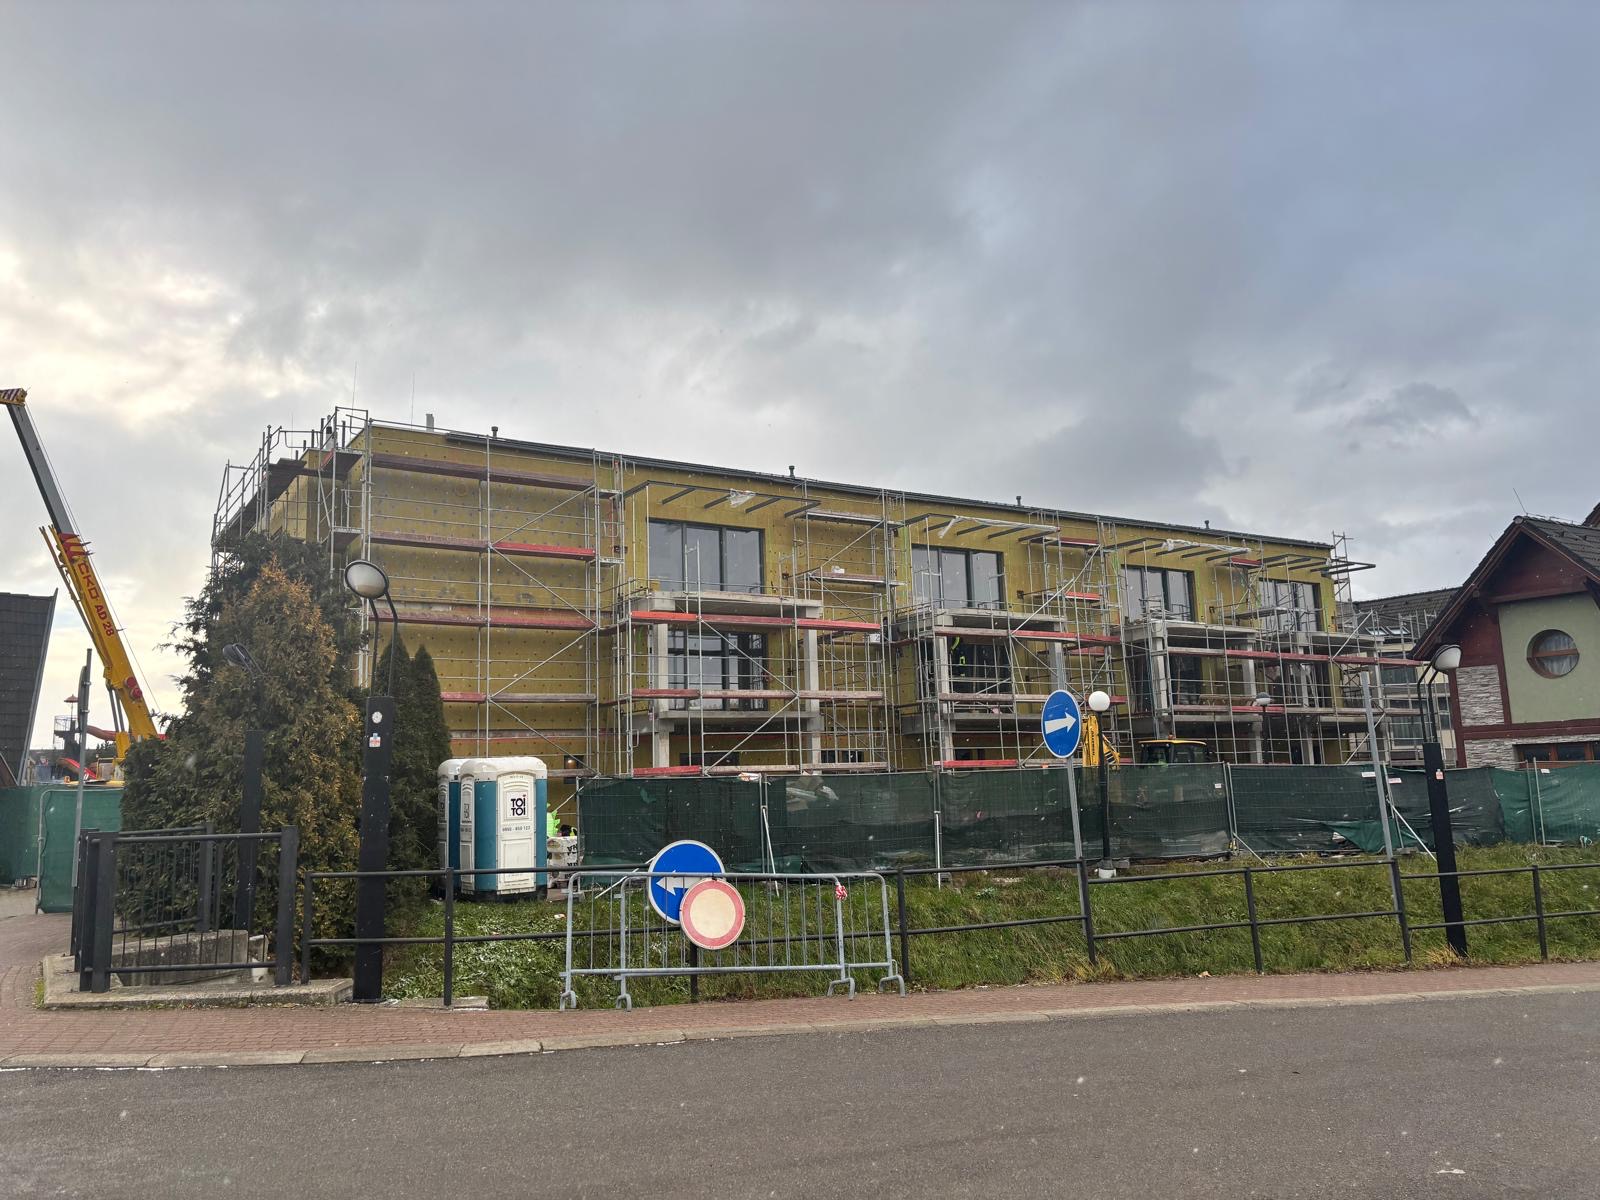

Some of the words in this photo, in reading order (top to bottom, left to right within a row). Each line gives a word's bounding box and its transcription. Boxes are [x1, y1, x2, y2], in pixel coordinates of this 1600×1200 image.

[95, 604, 107, 619] AD
[103, 622, 114, 636] 28
[510, 794, 527, 807] TOI
[511, 807, 526, 816] TOI
